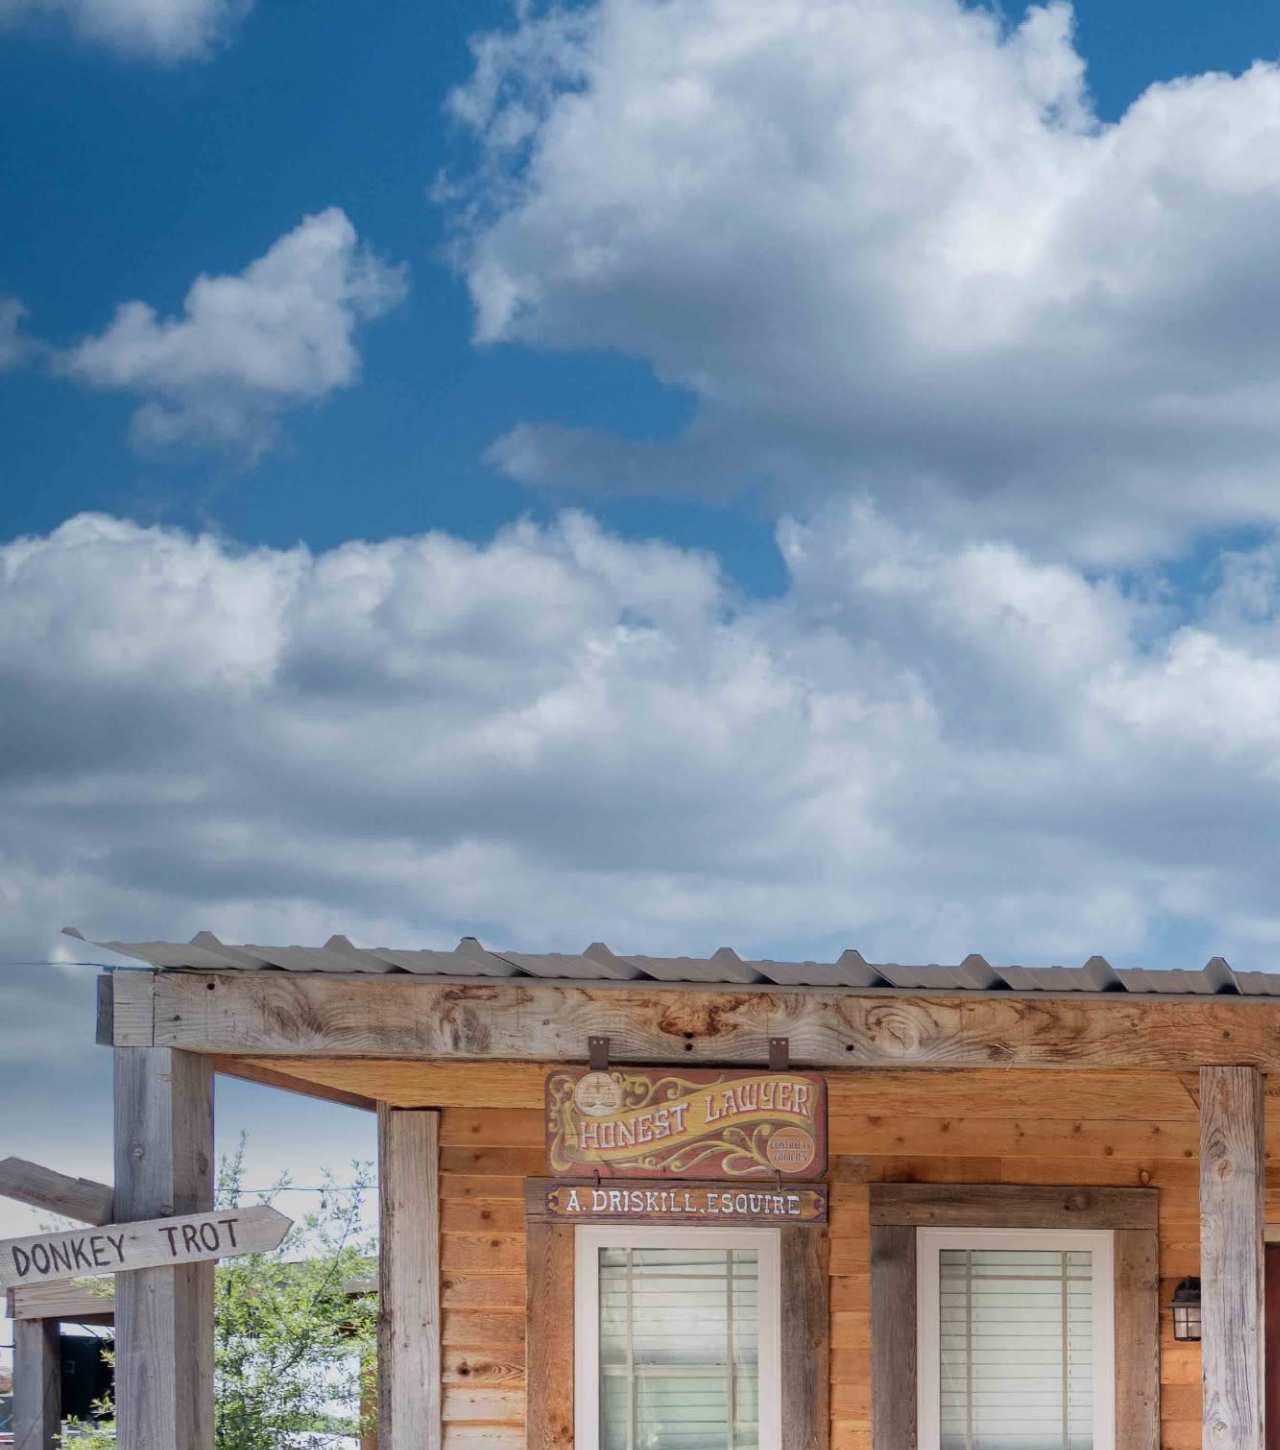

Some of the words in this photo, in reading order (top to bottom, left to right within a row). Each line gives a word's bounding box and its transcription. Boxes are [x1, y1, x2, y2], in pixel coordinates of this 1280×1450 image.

[579, 1103, 690, 1150] HONEST
[704, 1082, 813, 1122] LAWYER
[566, 1190, 588, 1212] A.
[706, 1193, 802, 1215] ESQUIRE
[12, 1234, 125, 1277] DONKEY
[158, 1218, 240, 1257] TROT
